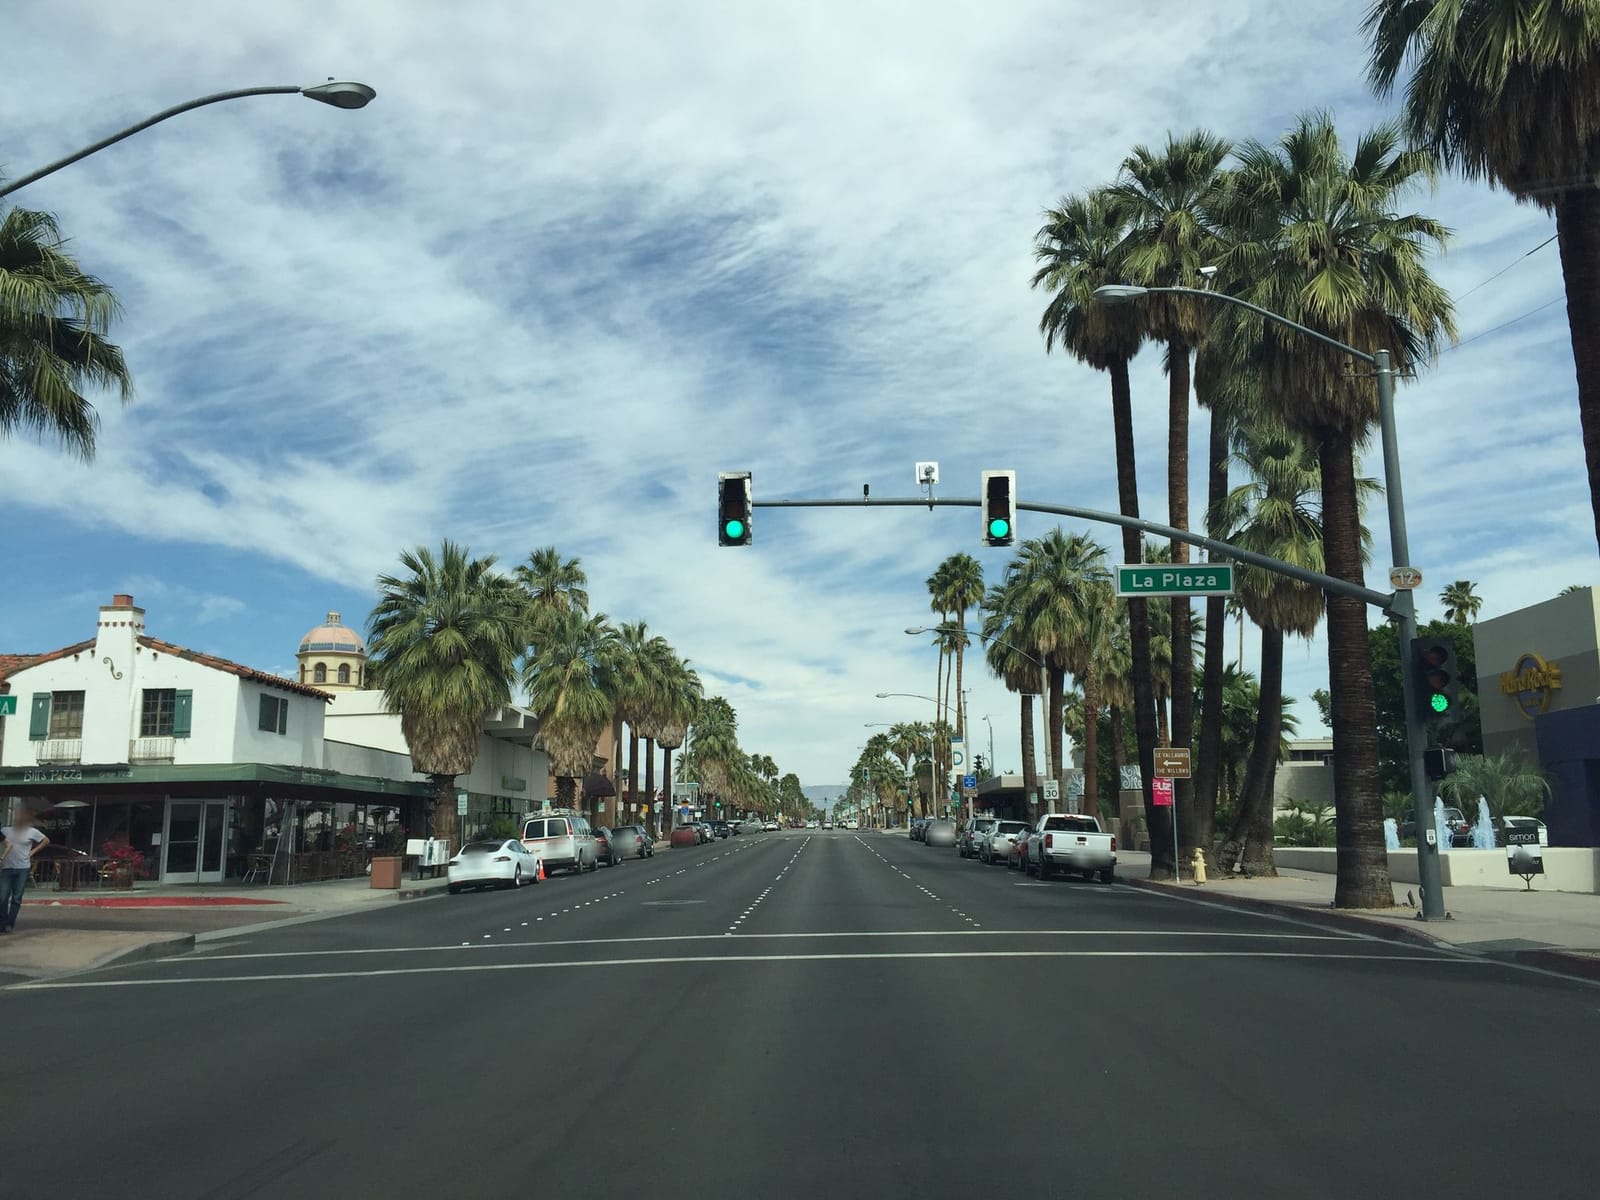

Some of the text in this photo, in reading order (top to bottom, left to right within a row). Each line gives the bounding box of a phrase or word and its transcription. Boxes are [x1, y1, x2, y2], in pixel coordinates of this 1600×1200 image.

[1132, 572, 1218, 588] La Plaza
[1398, 570, 1415, 585] 12
[23, 769, 82, 782] Bill's Pizza
[1045, 790, 1058, 798] 30
[1509, 833, 1536, 841] simon
